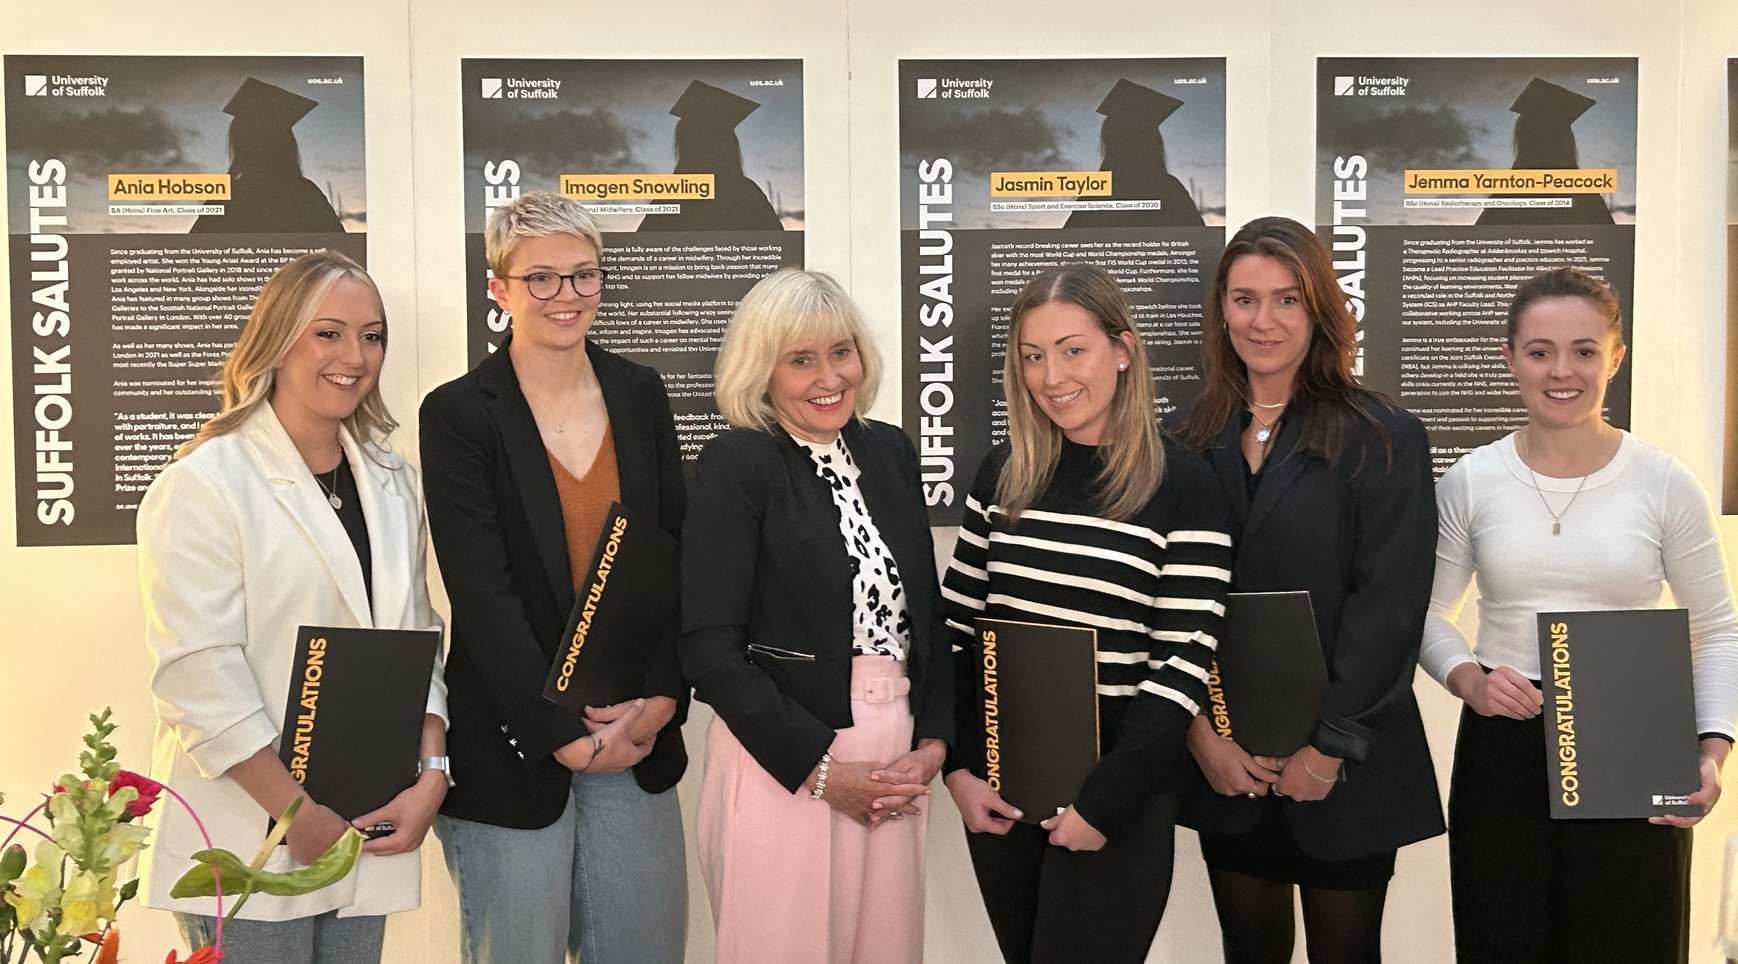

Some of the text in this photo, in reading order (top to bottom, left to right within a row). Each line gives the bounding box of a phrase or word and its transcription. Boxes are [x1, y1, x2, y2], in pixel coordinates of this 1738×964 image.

[51, 75, 109, 87] University
[507, 78, 561, 89] University
[941, 78, 993, 89] University
[1358, 76, 1409, 87] University
[51, 86, 106, 96] of Suffolk
[507, 88, 558, 99] of Suffolk
[941, 88, 990, 99] of Suffolk
[1358, 86, 1406, 96] of Suffolk
[113, 178, 227, 195] Ania Hobson
[995, 176, 1108, 195] Jasmin Taylor
[1408, 174, 1614, 189] Jemma Yarnton-Peacock
[565, 178, 710, 198] Imogen Snowling
[918, 157, 955, 507] SUFFOLK SALUTES
[28, 158, 75, 526] SUFFOLK SALUTES
[129, 412, 136, 421] a
[136, 412, 169, 421] student,
[169, 412, 176, 421] it
[176, 412, 194, 421] was
[194, 412, 216, 421] clear
[673, 413, 711, 421] feedback
[114, 421, 201, 432] with portraiture, and I
[114, 432, 124, 441] of
[124, 432, 152, 441] works.
[159, 432, 175, 441] has
[174, 432, 197, 441] been
[133, 443, 149, 451] the
[148, 444, 174, 453] years,
[115, 463, 164, 472] internationa
[115, 484, 137, 492] Prize
[556, 515, 628, 692] CONGRATULATIONS
[289, 637, 327, 785] GRATULATIONS
[982, 629, 1001, 792] ONGRATULATIONS
[1550, 622, 1580, 807] CONGRATULATIONS
